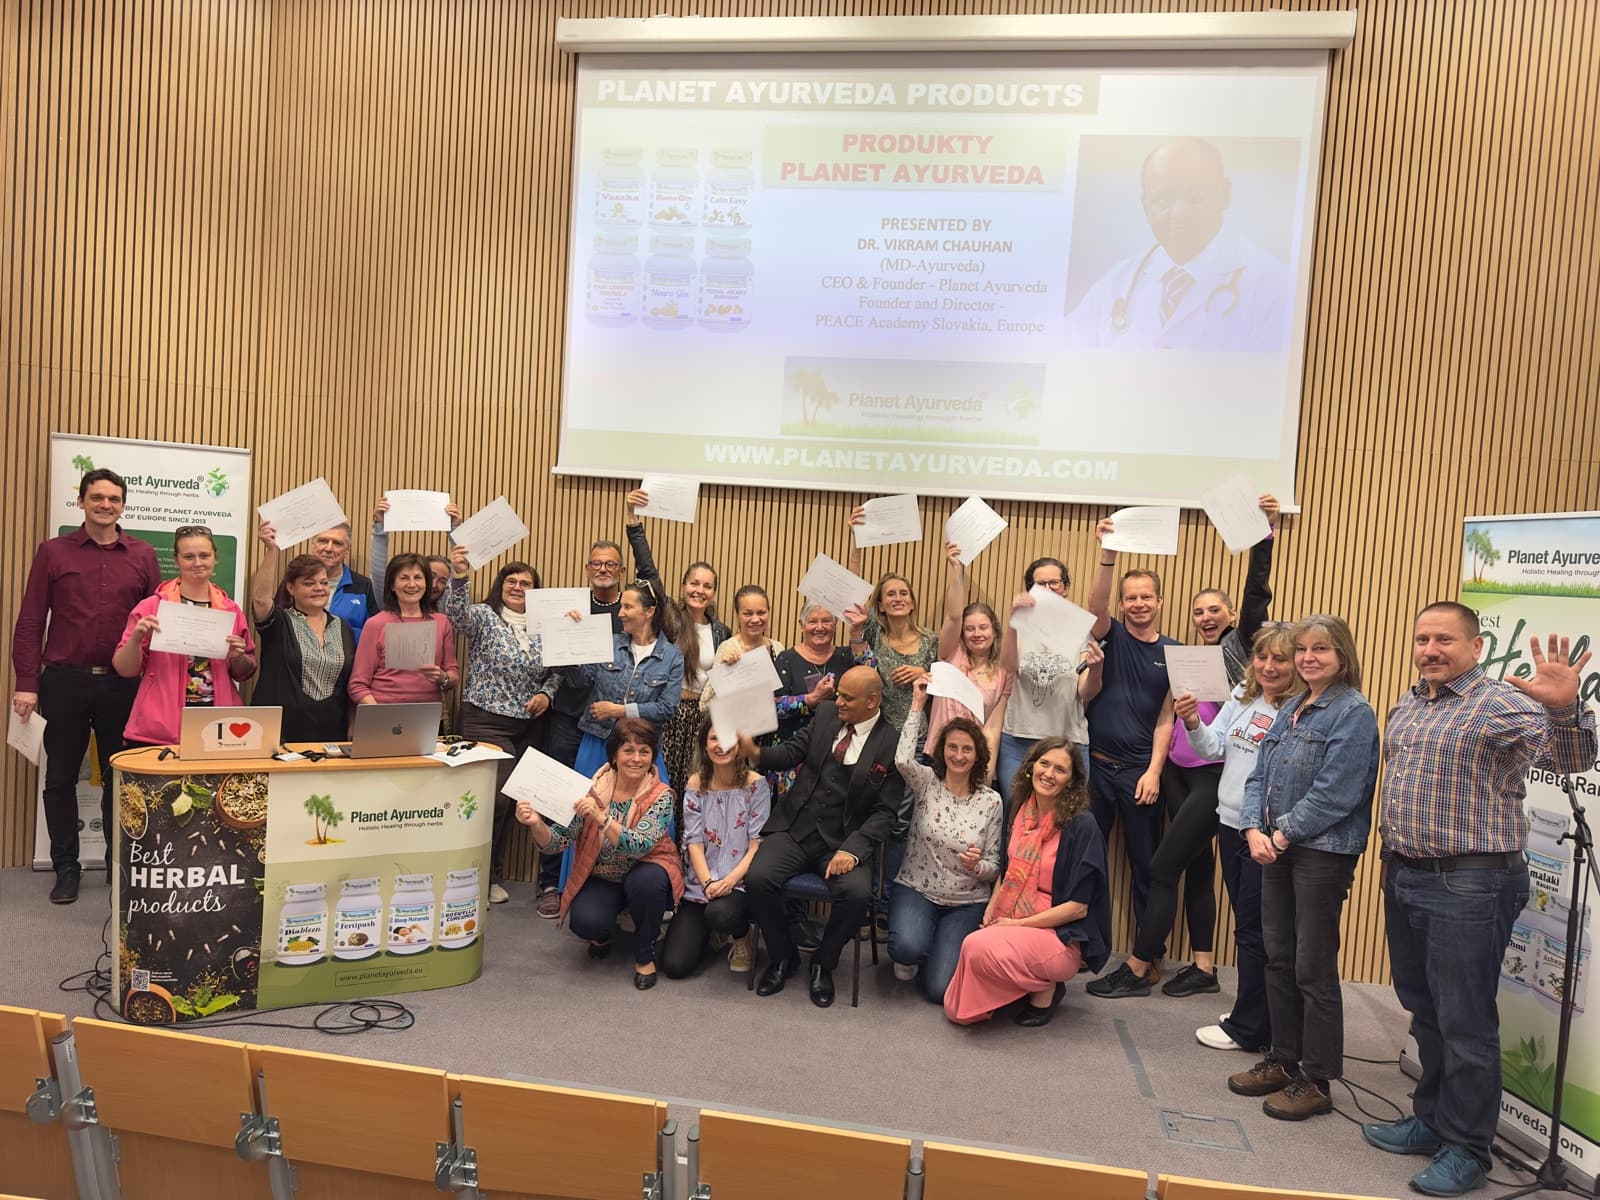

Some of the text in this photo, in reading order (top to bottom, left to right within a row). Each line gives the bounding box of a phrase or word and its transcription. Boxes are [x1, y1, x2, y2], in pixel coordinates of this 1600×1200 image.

[598, 79, 1083, 107] PLANET AYURVEDA PRODUCTS
[842, 134, 994, 154] PRODUKTY
[780, 162, 1045, 185] PLANET AYURVEDA
[881, 217, 992, 232] PRESENTED BY
[857, 238, 1013, 253] DR. VIKRAM CHAUHAN
[880, 258, 986, 274] (MD-Ayurveda)
[821, 276, 853, 289] CEO
[856, 277, 868, 289] &
[872, 277, 927, 291] Founder
[939, 279, 979, 292] Planet
[983, 280, 1048, 295] Ayurveda
[859, 296, 912, 310] Founder
[914, 297, 938, 310] and
[942, 298, 996, 312] Director
[815, 314, 1044, 334] PEACE Academy Slovakia, Europe
[848, 392, 984, 412] Planet Ayurveda
[704, 443, 1118, 481] WWW.PLANETAYURVEDA.COM
[124, 474, 143, 486] net
[1508, 550, 1600, 567] Planet Ayurve
[1526, 768, 1569, 788] plete
[350, 810, 388, 823] Planet
[129, 840, 175, 866] Best
[130, 864, 246, 889] HERBAL
[1529, 869, 1560, 887] malaki
[127, 889, 227, 923] products
[340, 920, 375, 930] Fertipush
[339, 967, 424, 982] www.planetayurveda.eu
